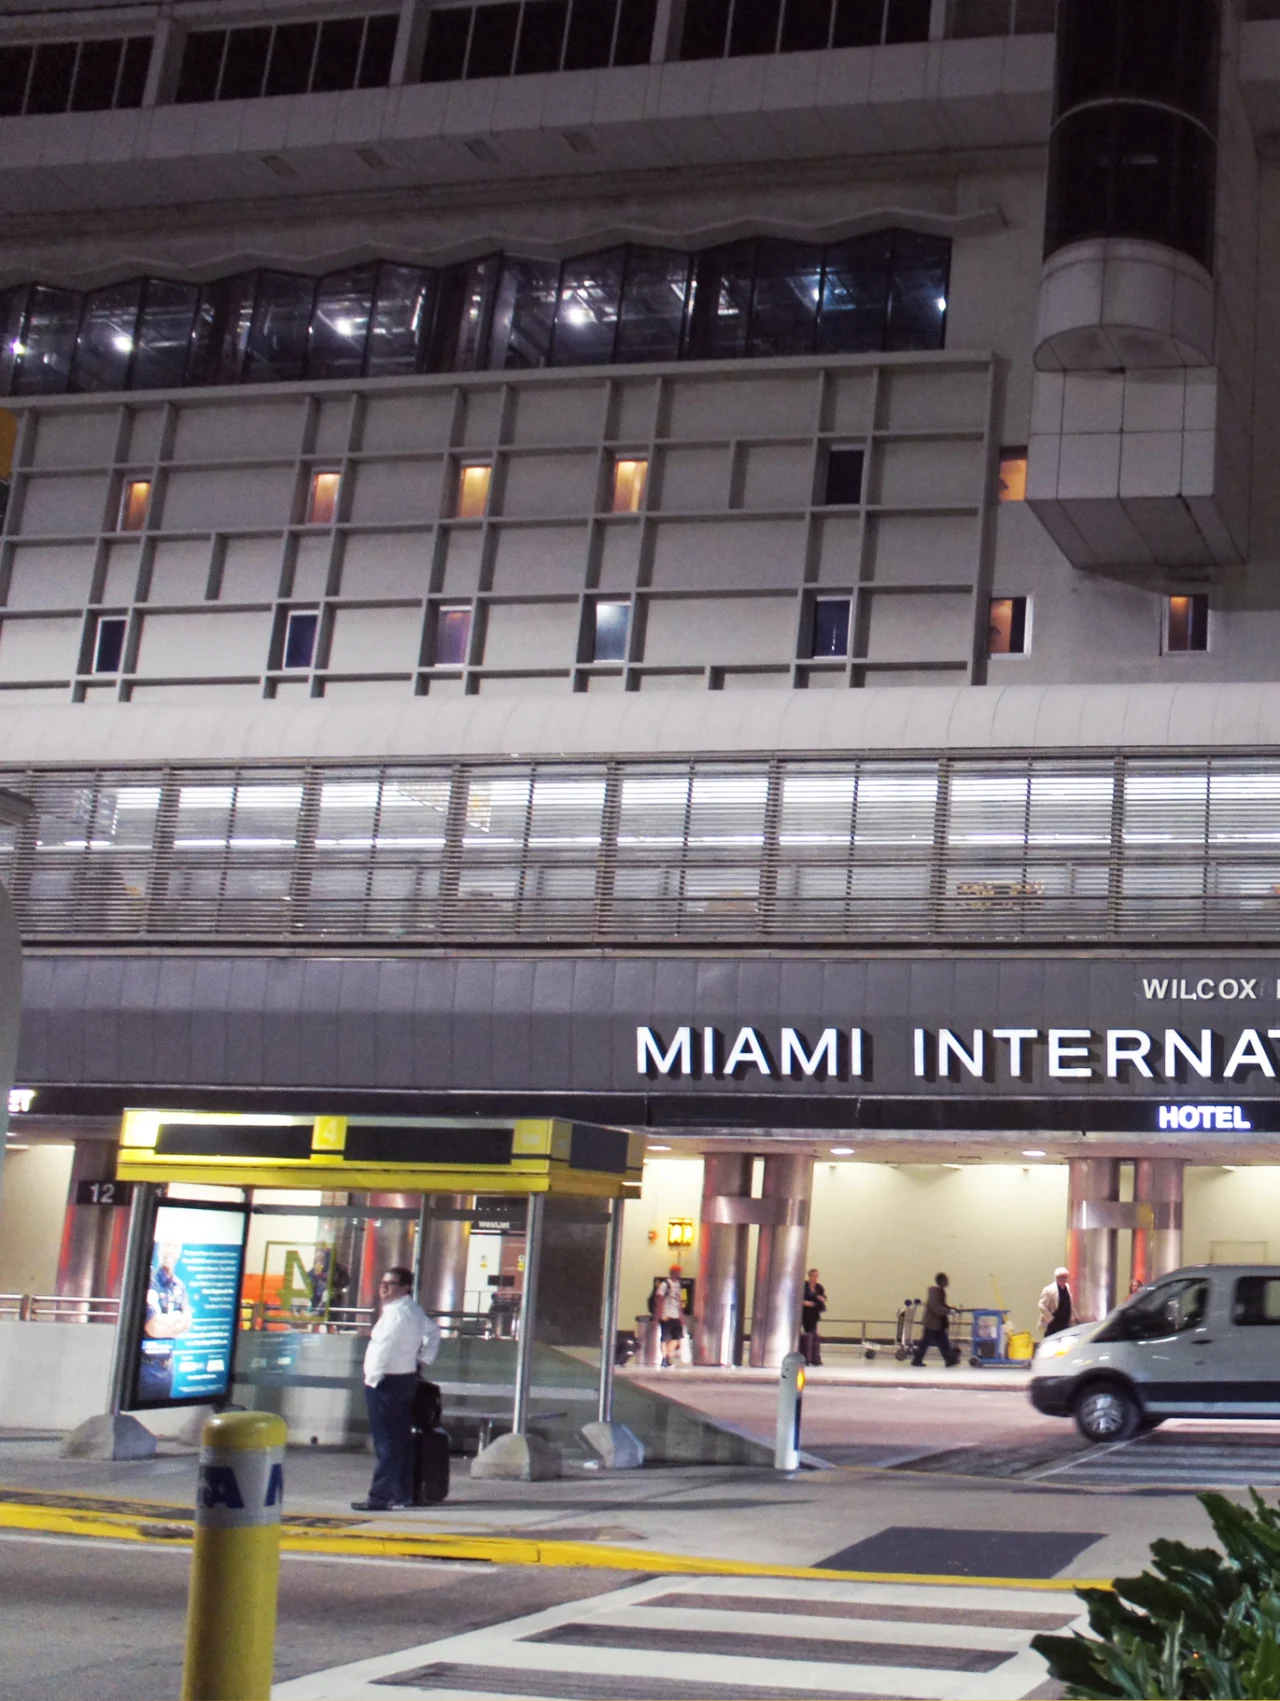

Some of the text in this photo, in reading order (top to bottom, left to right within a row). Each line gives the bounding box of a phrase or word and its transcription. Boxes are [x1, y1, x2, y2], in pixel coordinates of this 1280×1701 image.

[1141, 977, 1258, 1001] WILCOX
[635, 1025, 863, 1076] MIAMI
[1157, 1104, 1253, 1131] HOTEL
[322, 1118, 339, 1144] 4
[90, 1183, 115, 1203] 12
